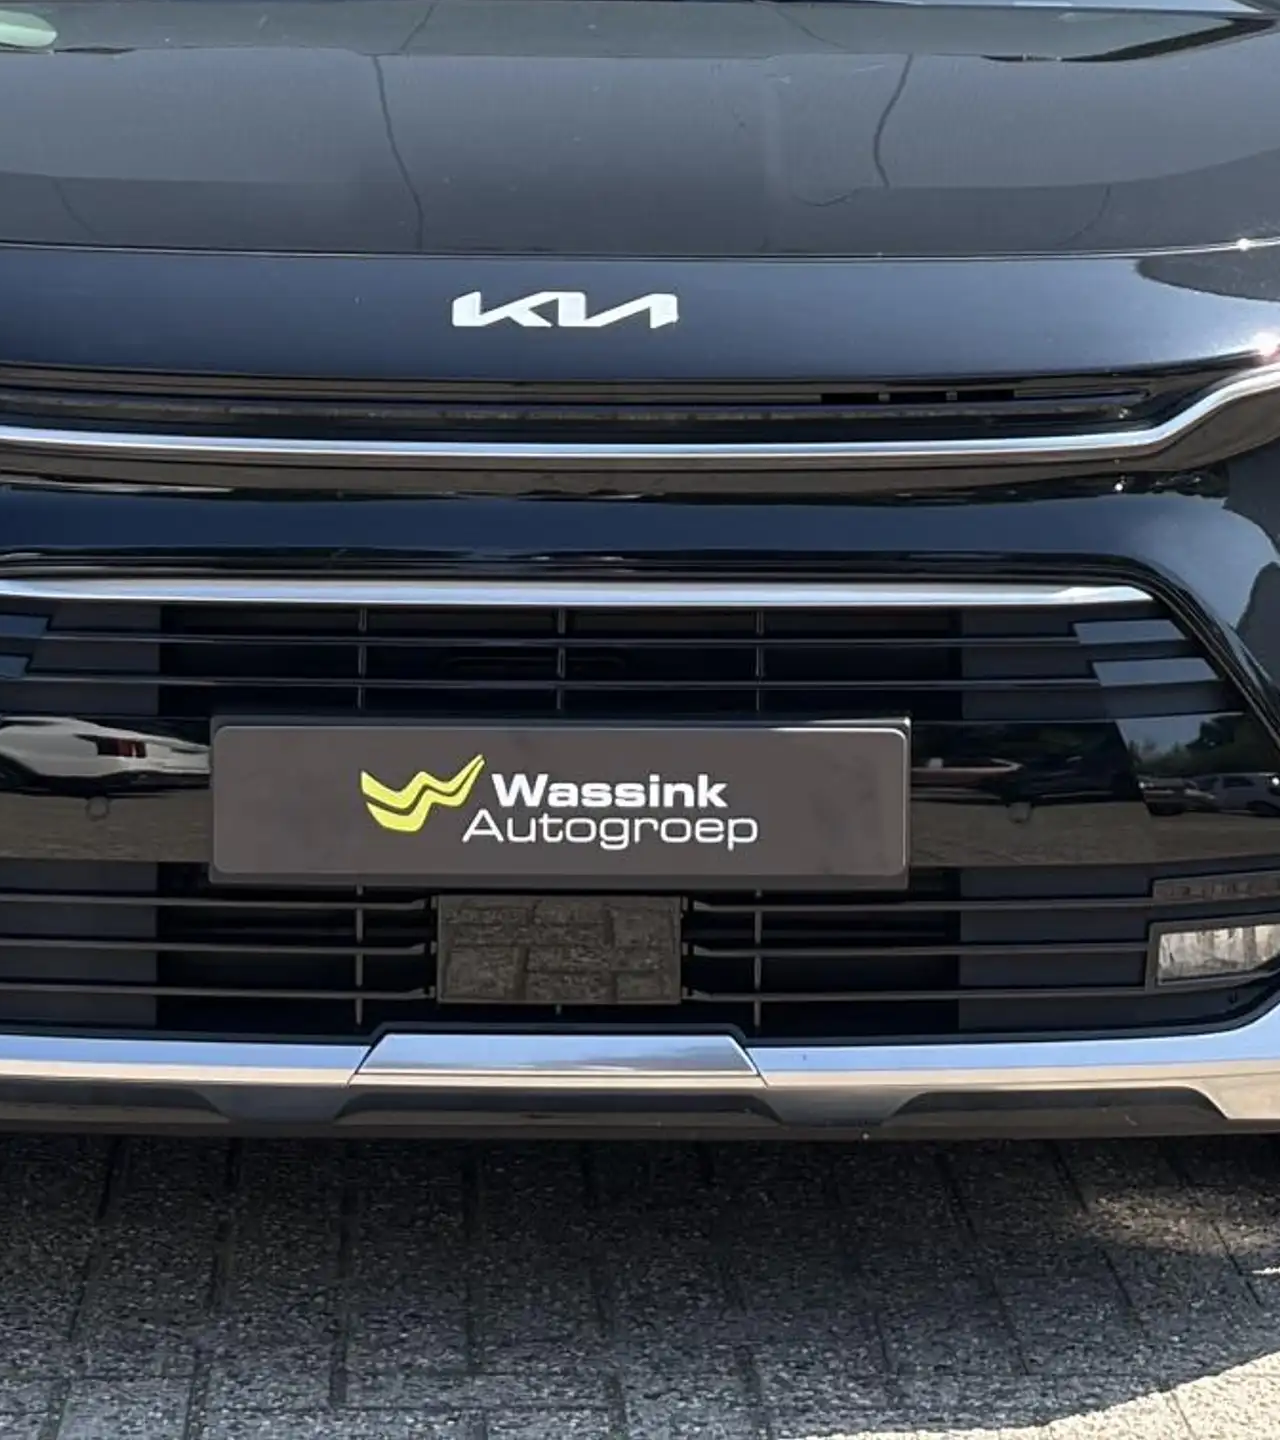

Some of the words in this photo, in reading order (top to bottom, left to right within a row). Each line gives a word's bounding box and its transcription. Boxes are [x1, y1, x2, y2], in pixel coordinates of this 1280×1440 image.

[452, 291, 678, 328] KIA
[491, 773, 728, 808] Wassink
[462, 809, 759, 851] Autogroep
